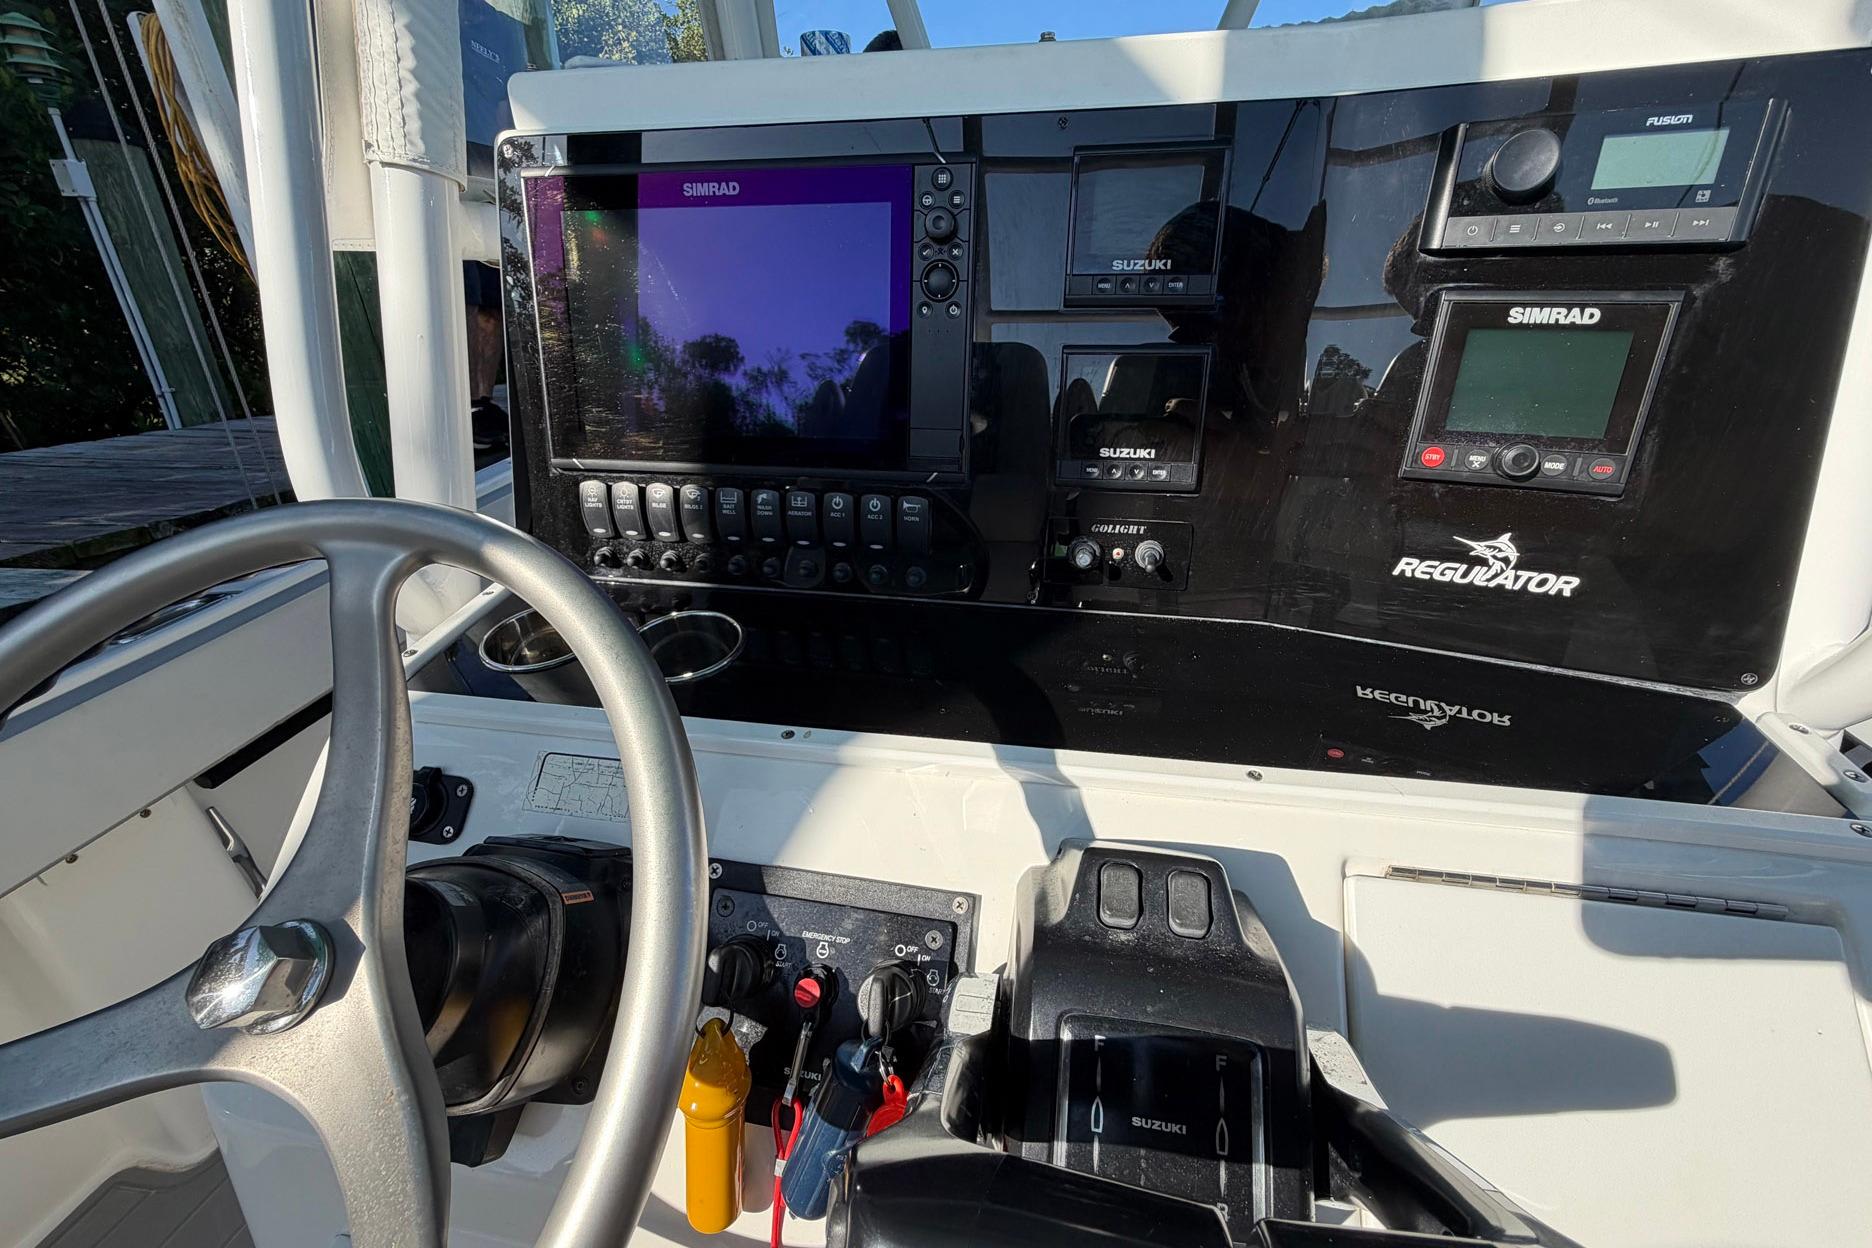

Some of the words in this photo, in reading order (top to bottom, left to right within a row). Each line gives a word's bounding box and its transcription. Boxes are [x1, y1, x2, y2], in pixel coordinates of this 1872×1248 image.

[1646, 114, 1693, 127] FUSION
[683, 182, 740, 196] SIMRAD
[1111, 259, 1172, 271] SUZUKI
[1507, 307, 1602, 325] SIMRAD
[1099, 447, 1156, 459] SUZUKI
[1424, 453, 1441, 462] STBY
[1469, 455, 1487, 463] MENU
[1543, 461, 1565, 471] MODE
[1593, 465, 1613, 474] AUTO
[1091, 524, 1147, 534] GOLIGHT
[1392, 557, 1580, 597] REGULATOR
[757, 921, 769, 929] OFF
[802, 931, 836, 942] EMERGENCY
[836, 936, 850, 944] STOP
[907, 945, 919, 953] OFF
[921, 954, 931, 962] ON
[1094, 1035, 1106, 1051] F
[1215, 1054, 1228, 1072] F
[1131, 1116, 1187, 1136] SUZUKI
